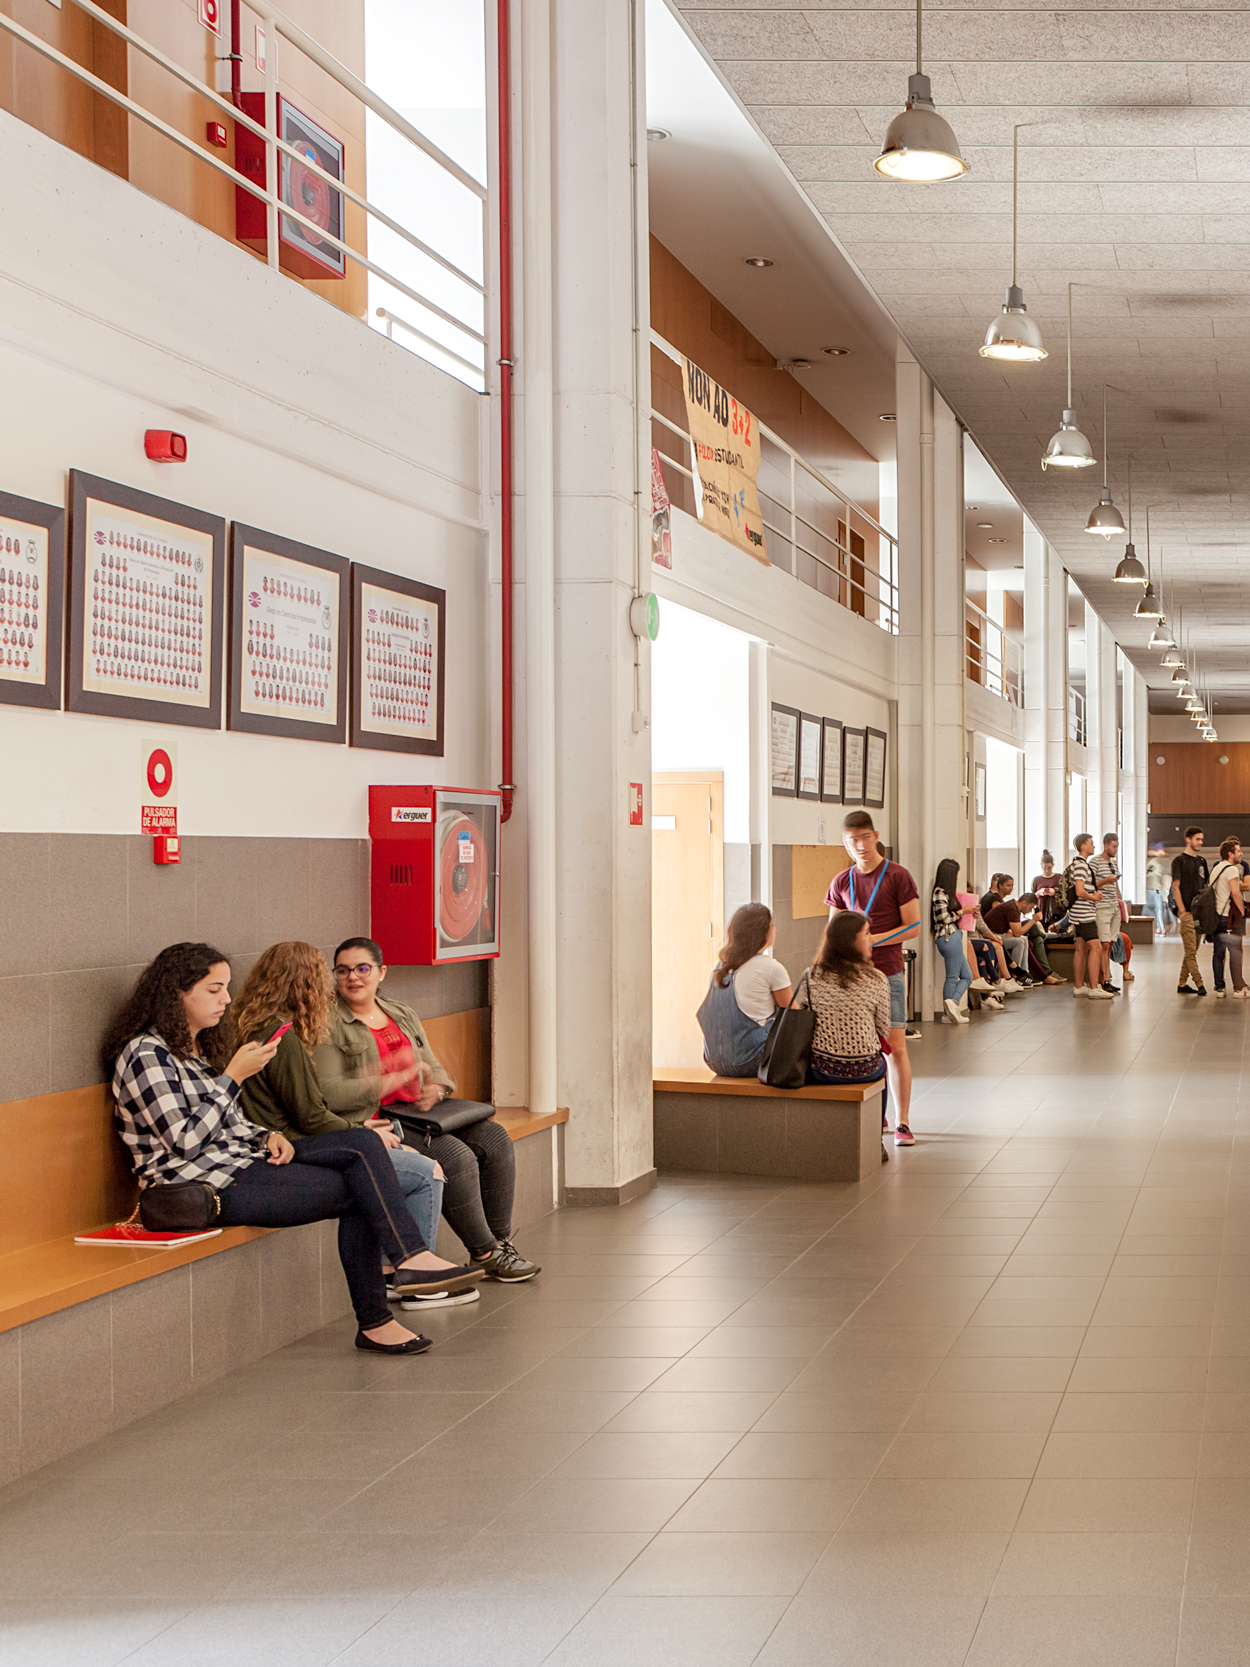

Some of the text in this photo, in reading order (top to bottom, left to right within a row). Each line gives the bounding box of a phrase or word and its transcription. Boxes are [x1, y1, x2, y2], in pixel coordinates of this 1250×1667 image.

[731, 397, 752, 448] 3+2
[144, 807, 175, 818] PULSADOR
[403, 811, 429, 822] erguer
[142, 817, 176, 828] DE ALARMA
